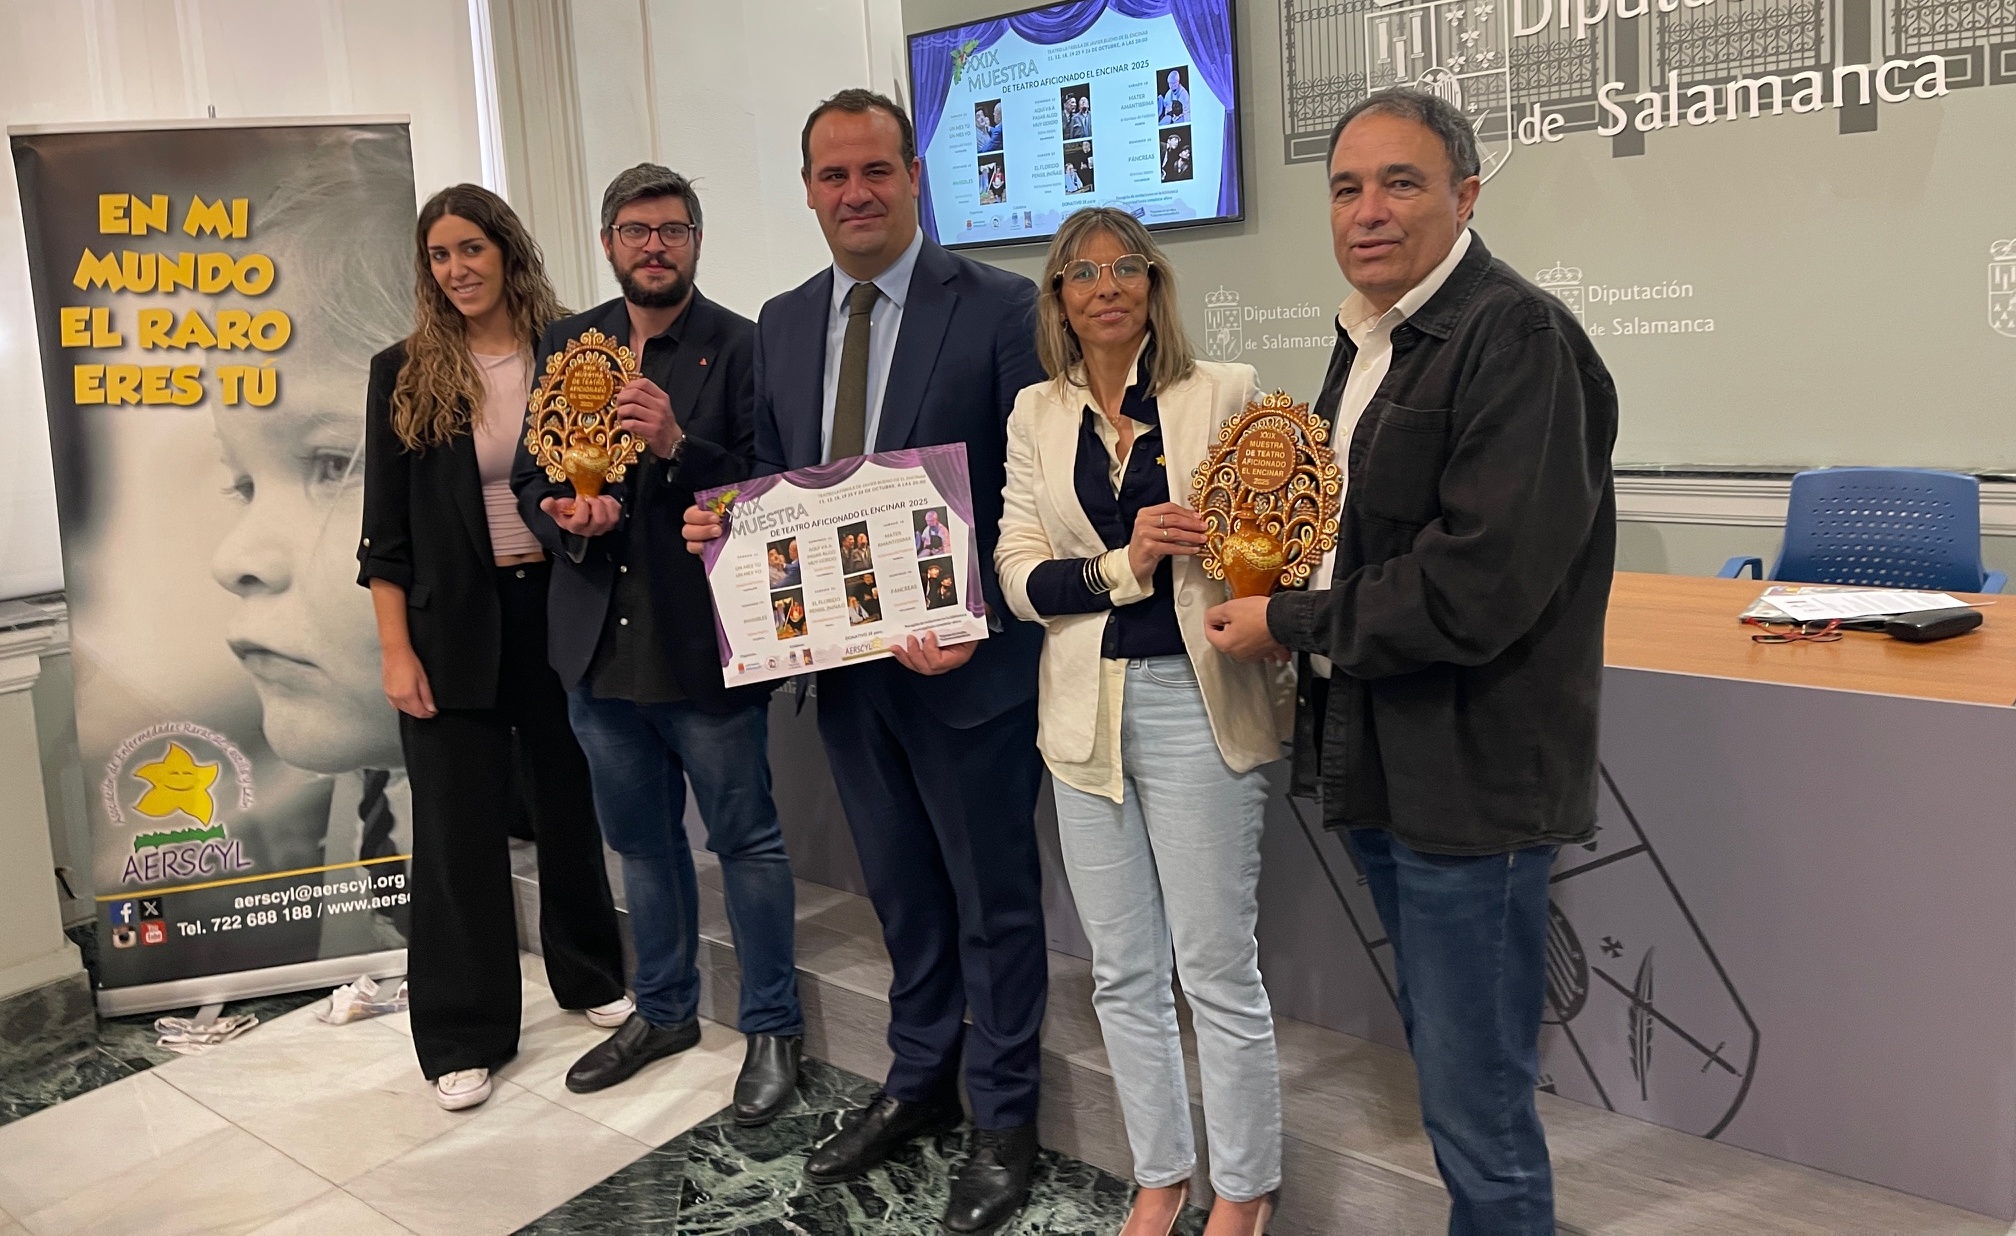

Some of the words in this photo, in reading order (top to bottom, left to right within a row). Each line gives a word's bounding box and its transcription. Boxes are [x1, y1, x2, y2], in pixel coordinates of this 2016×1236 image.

[966, 48, 1000, 74] XXIX
[968, 60, 1039, 92] MUESTRA
[1002, 84, 1012, 94] DE
[1013, 80, 1040, 92] TEATRO
[1040, 71, 1086, 88] AFICIONADO
[1086, 70, 1094, 78] EL
[1096, 63, 1128, 77] ENCINAR
[1132, 60, 1150, 71] 2025
[1518, 102, 1566, 145] de
[1597, 54, 1950, 137] Salamanca
[99, 194, 168, 235] EN
[182, 195, 248, 239] MI
[73, 248, 274, 295] MUNDO
[1588, 280, 1694, 304] Diputación
[60, 307, 122, 347] EL
[138, 308, 290, 351] RARO
[1244, 303, 1321, 324] Diputación
[1588, 322, 1606, 336] de
[1612, 316, 1714, 336] Salamanca
[1244, 336, 1258, 350] de
[1262, 333, 1336, 350] Salamanca
[74, 364, 203, 406] ERES
[217, 358, 278, 406] TÚ
[1250, 440, 1284, 449] MUESTRA
[1260, 431, 1276, 440] XXIX
[1242, 458, 1286, 468] AFICIONADO
[1257, 450, 1286, 458] TEATRO
[1252, 468, 1284, 477] ENCINAR
[732, 503, 809, 539] MUESTRA
[770, 529, 780, 538] DE
[782, 522, 810, 535] TEATRO
[812, 511, 860, 528] AFICIONADO
[860, 508, 869, 517] EL
[870, 502, 906, 514] ENCINAR
[909, 498, 928, 508] 2025
[846, 643, 872, 655] AERSCYL
[122, 841, 252, 882] AERSCYL
[234, 873, 405, 909] aerscyl@aerscyl.org
[178, 922, 206, 936] Tel.
[212, 915, 242, 932] 722
[246, 911, 277, 928] 688
[283, 905, 312, 922] 188
[316, 902, 322, 918] /
